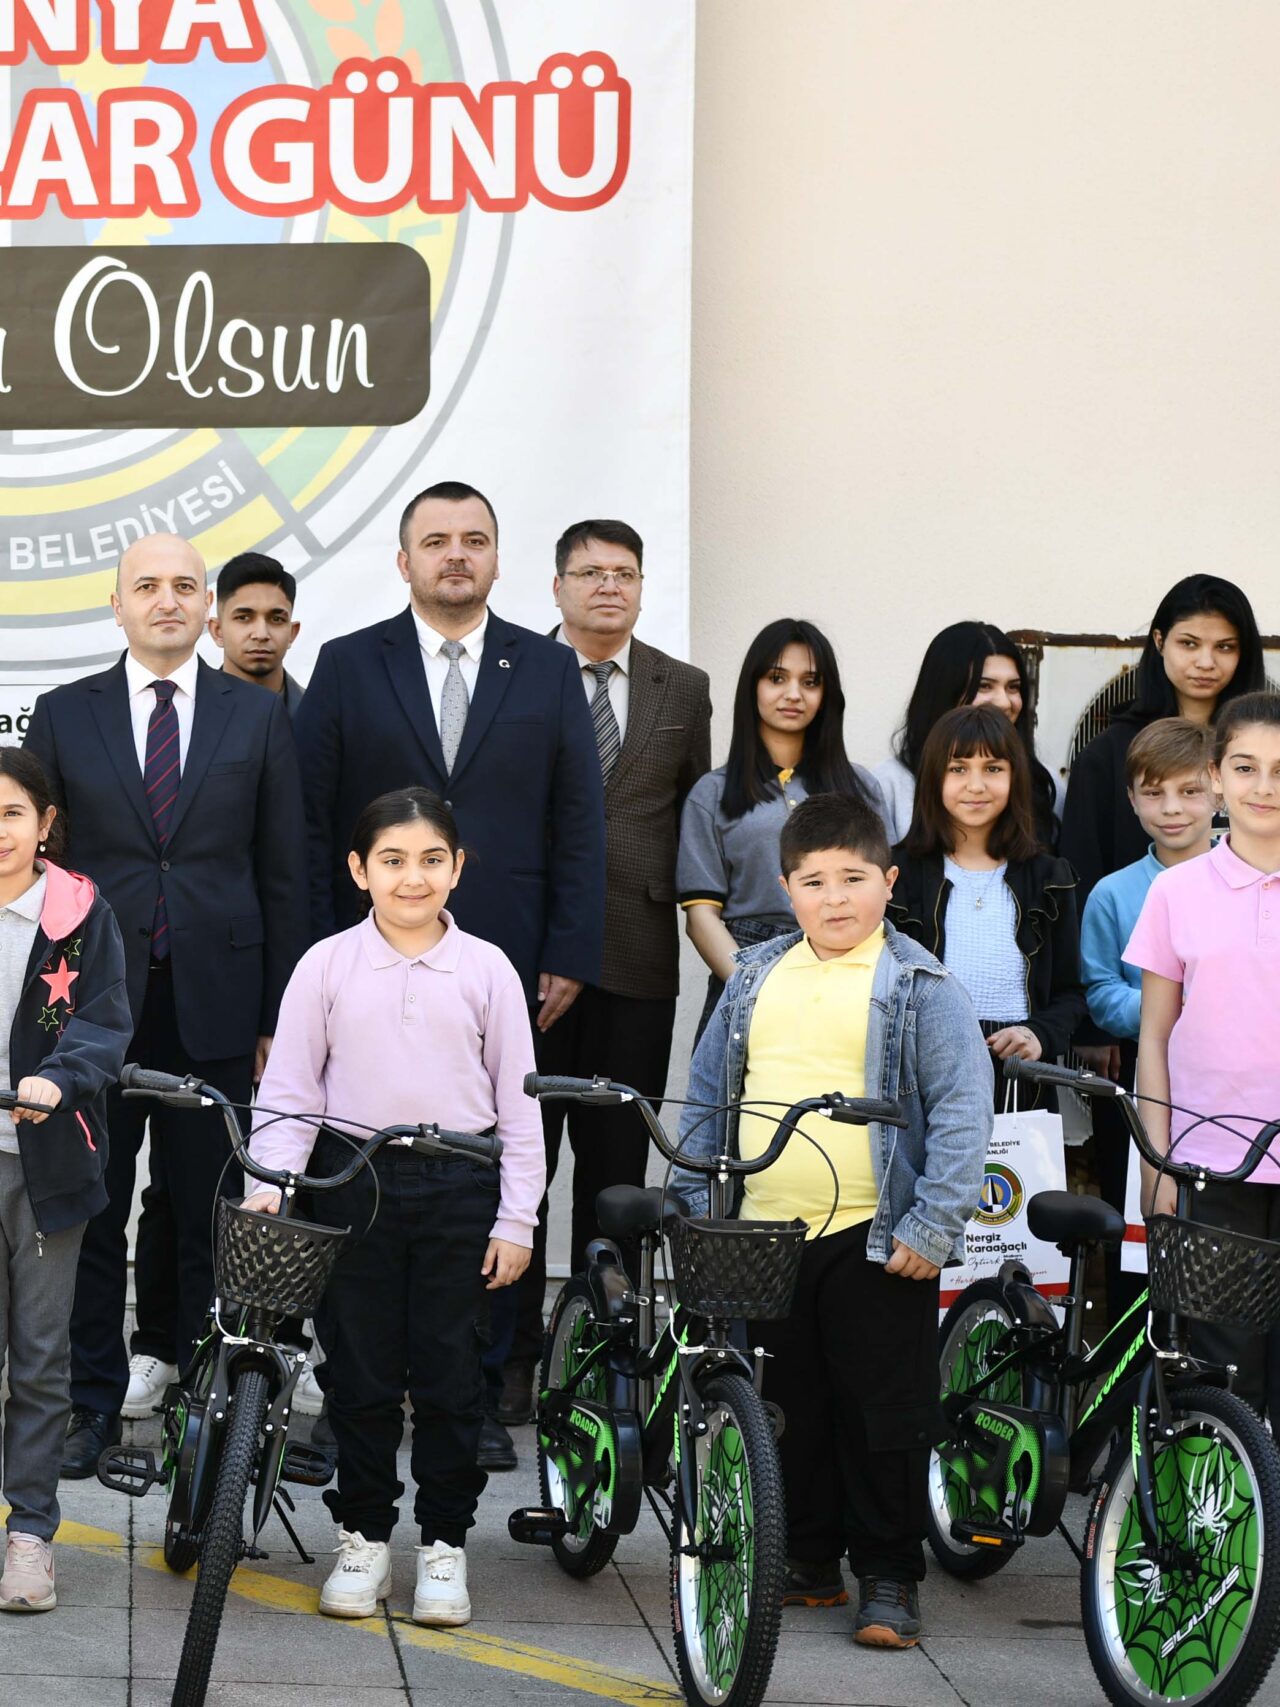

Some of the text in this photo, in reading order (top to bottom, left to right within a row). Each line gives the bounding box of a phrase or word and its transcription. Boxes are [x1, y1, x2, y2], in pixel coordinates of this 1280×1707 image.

[217, 57, 626, 210] GÜNÜ
[53, 255, 375, 399] Olsun
[9, 459, 246, 570] BELEDİYESİ
[966, 1232, 1001, 1244] Nergiz
[966, 1241, 1028, 1254] Karaağaçlı
[569, 1409, 598, 1439] ROADER
[974, 1411, 1015, 1442] ROADER
